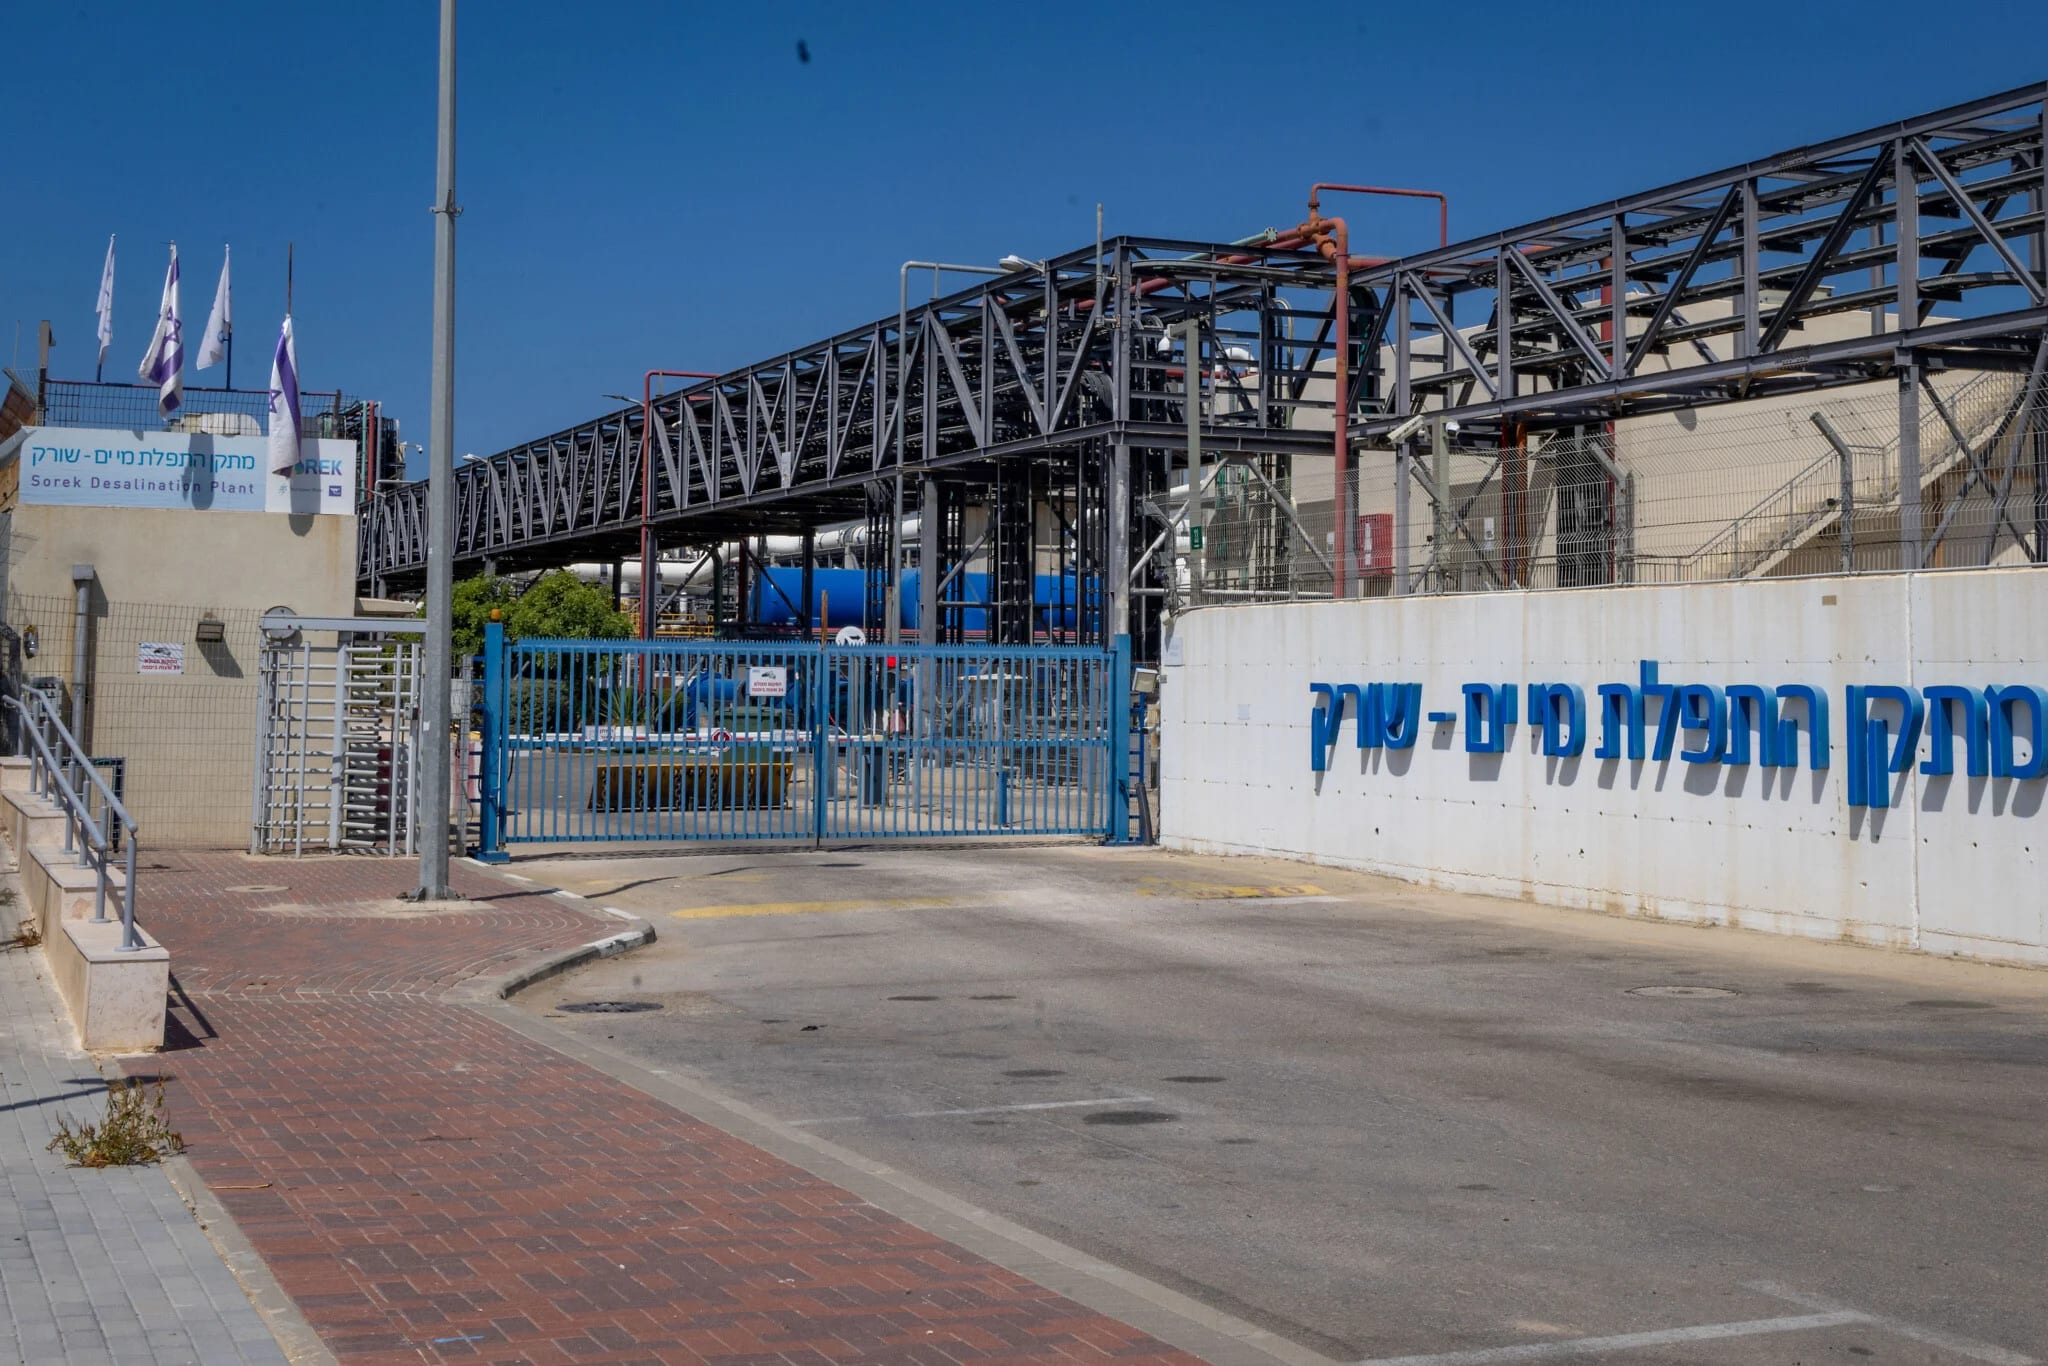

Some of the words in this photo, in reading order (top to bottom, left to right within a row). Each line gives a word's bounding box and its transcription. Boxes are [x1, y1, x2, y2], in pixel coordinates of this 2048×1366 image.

[31, 446, 81, 467] שורק
[137, 448, 206, 467] התפלת
[210, 454, 256, 473] מתקן
[31, 474, 82, 489] Sorek
[91, 476, 201, 493] Desalination
[211, 480, 254, 494] Plant
[1595, 660, 1829, 771] התפלת
[1310, 683, 1422, 771] שורק
[1846, 685, 2048, 808] מתקן
